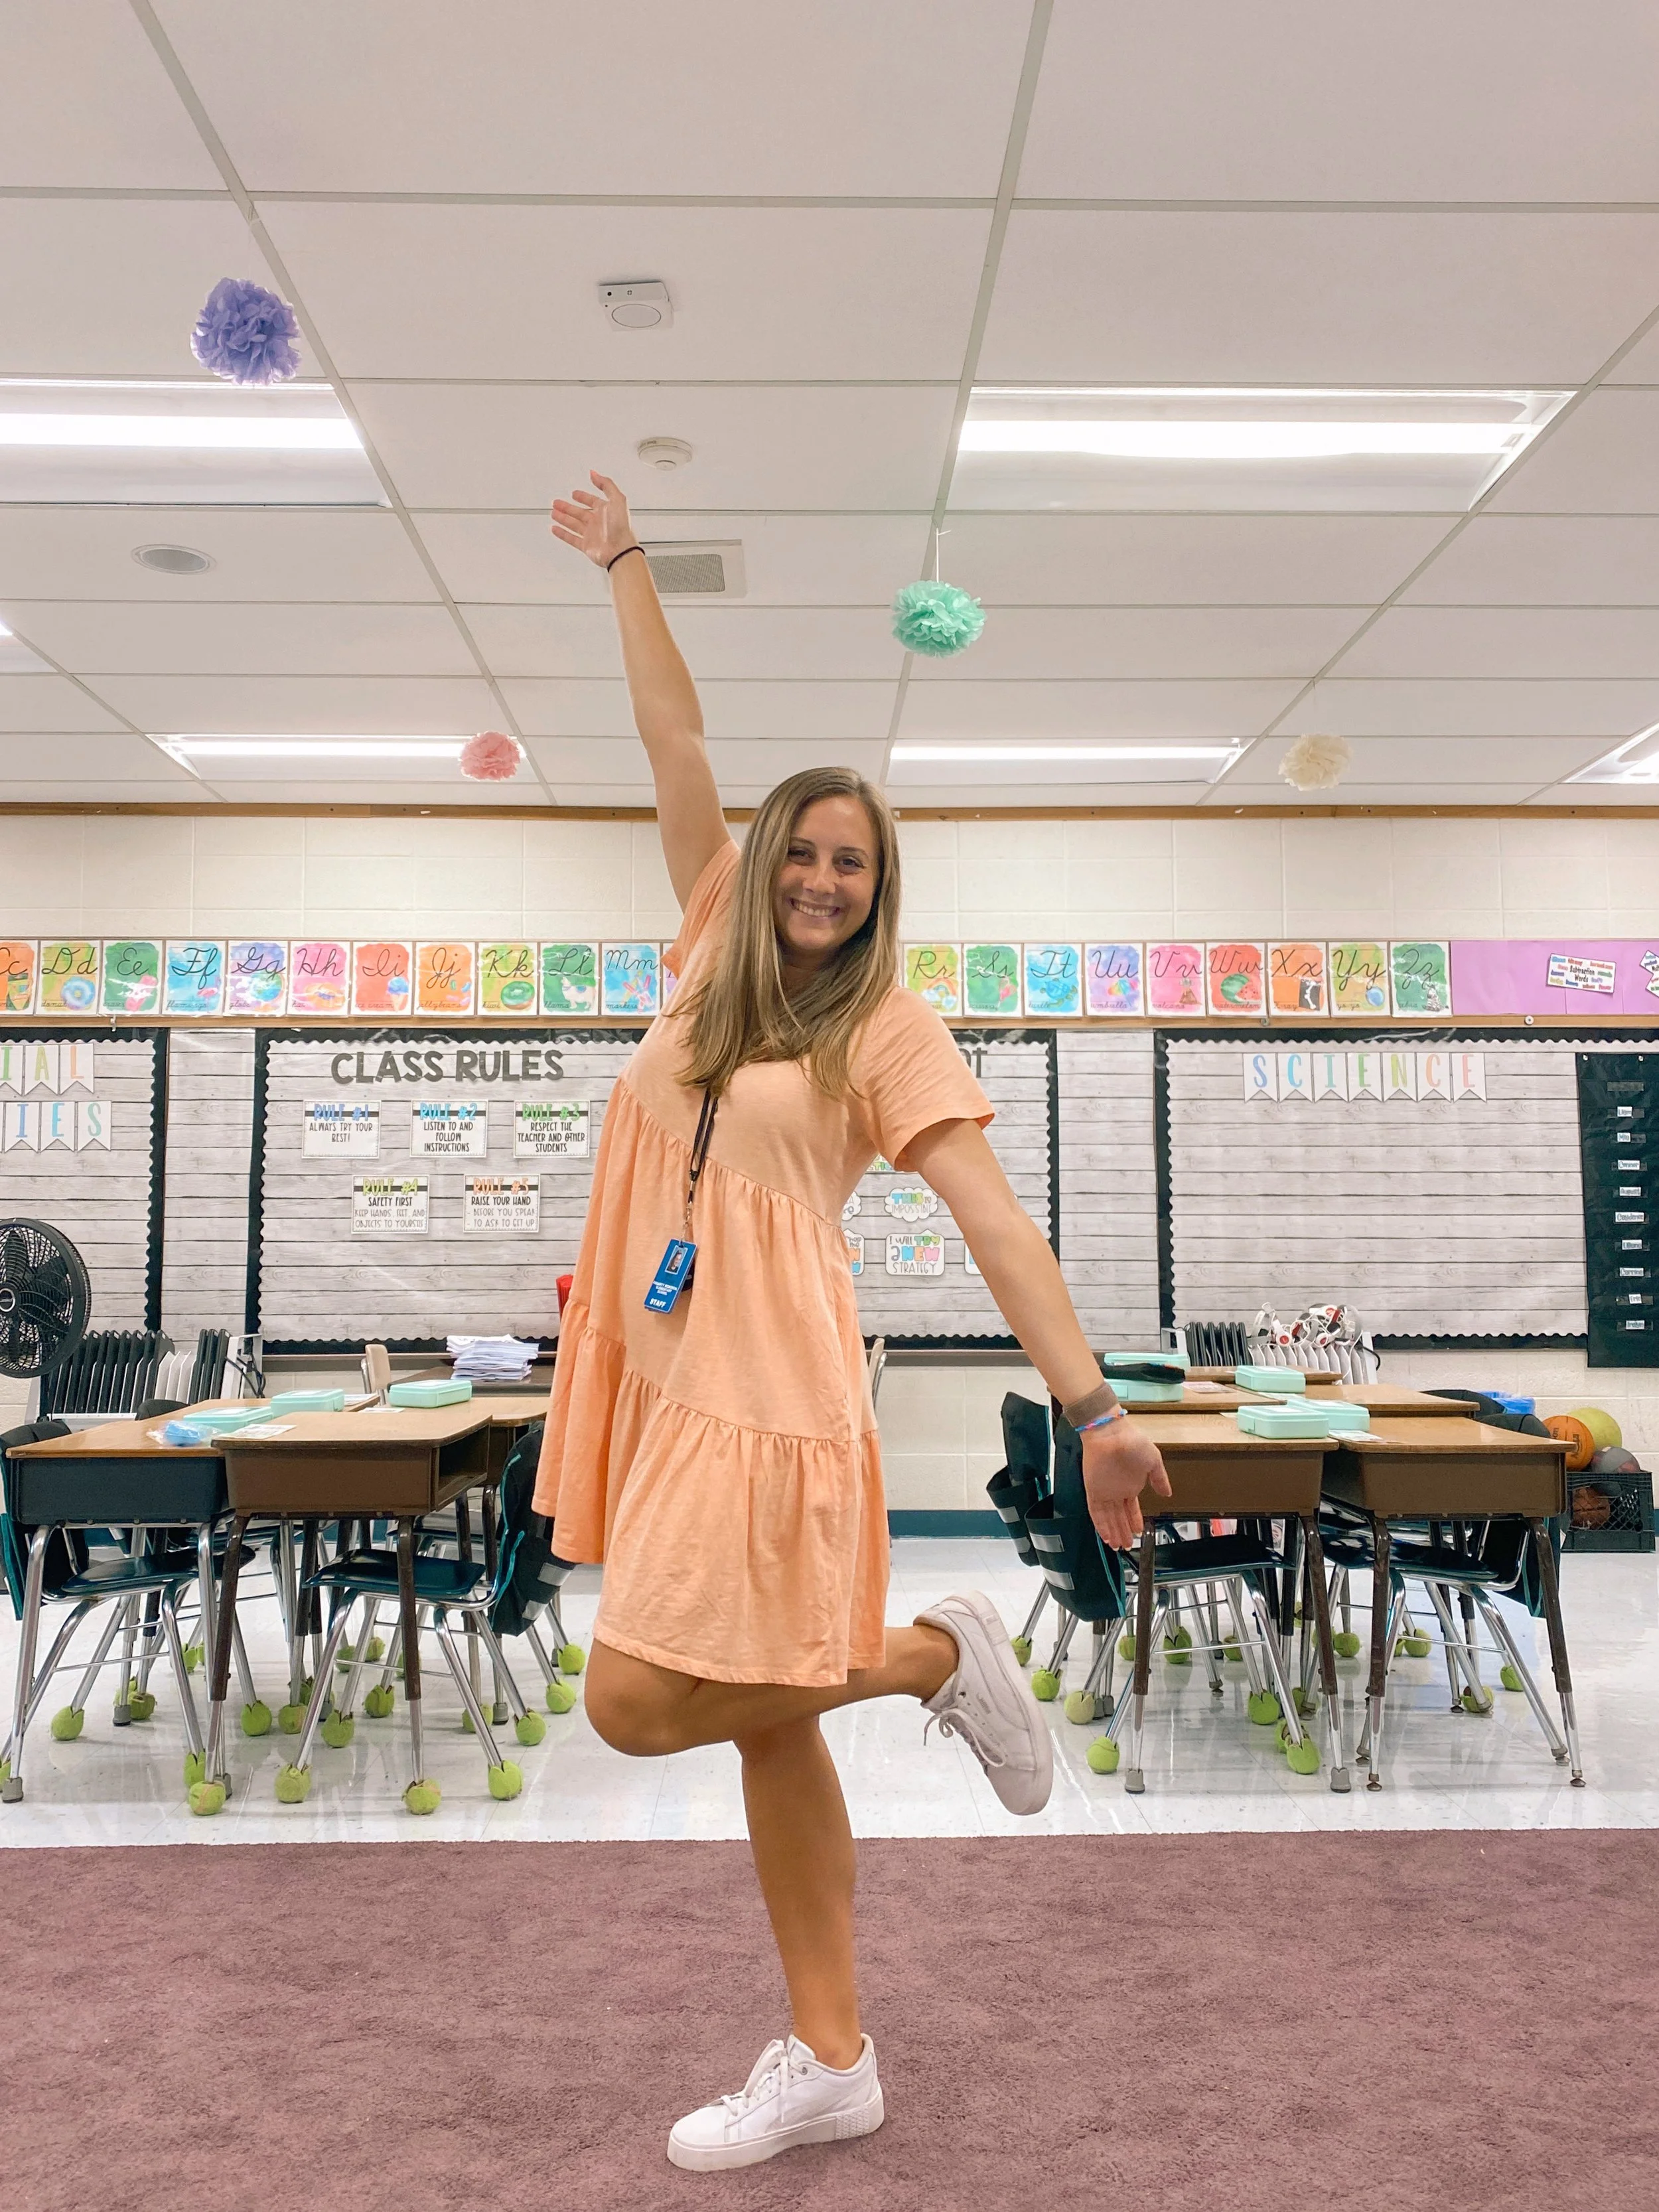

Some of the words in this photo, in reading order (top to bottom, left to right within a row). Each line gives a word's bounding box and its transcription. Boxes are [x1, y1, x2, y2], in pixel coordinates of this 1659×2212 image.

[42, 947, 98, 974] Dd
[117, 948, 149, 976] Ee
[171, 947, 218, 990] Ff
[231, 947, 286, 981] Gg
[297, 948, 344, 976] Hh
[362, 947, 405, 976] Ii
[426, 947, 461, 989] Jj
[486, 949, 534, 978] Kk
[549, 948, 593, 976] Ll
[606, 950, 659, 971] Mm
[912, 951, 955, 979] Rr
[972, 950, 1015, 979] Ss
[1031, 950, 1076, 979] Tt
[1092, 950, 1139, 978] Uu
[1150, 950, 1202, 978] Vv
[1209, 950, 1263, 974] Ww
[1272, 950, 1323, 978] Xx
[1333, 950, 1386, 991] Yy
[1395, 950, 1439, 990] Zz
[1574, 974, 1589, 983] Words
[331, 1051, 444, 1084] CLASS
[455, 1050, 564, 1082] RULES
[1254, 1053, 1475, 1088] SCIENCE
[313, 1103, 345, 1122] RULE
[352, 1104, 369, 1122] #1
[419, 1102, 451, 1122] RULE
[458, 1102, 478, 1122] #2
[522, 1102, 553, 1122] RULE
[559, 1102, 581, 1122] #3
[309, 1122, 336, 1132] ALWAYS
[340, 1122, 352, 1131] TRY
[356, 1122, 373, 1132] YOUR
[423, 1122, 445, 1131] LISTEN
[449, 1122, 457, 1131] TO
[459, 1122, 473, 1131] AND
[530, 1122, 557, 1132] RESPECT
[561, 1122, 572, 1131] THE
[331, 1133, 350, 1143] BEST!
[435, 1132, 461, 1142] FOLLOW
[518, 1132, 546, 1142] TEACHER
[549, 1133, 562, 1142] AND
[565, 1133, 585, 1142] OTHER
[424, 1143, 470, 1152] INSTRUCTIONS
[536, 1143, 567, 1153] STUDENTS
[363, 1178, 394, 1196] RULE
[401, 1178, 418, 1196] #4
[473, 1178, 504, 1196] RULE
[511, 1178, 529, 1195] #5
[368, 1197, 393, 1207] SAFETY
[396, 1197, 413, 1207] FIRST
[471, 1196, 490, 1206] RAISE
[493, 1196, 510, 1206] YOUR
[513, 1196, 531, 1206] HAND
[891, 1192, 924, 1205] THIS
[473, 1218, 482, 1227] TO
[485, 1218, 499, 1227] ASK
[502, 1218, 510, 1227] TO
[513, 1218, 524, 1227] GET
[526, 1218, 535, 1227] UP
[516, 1208, 535, 1217] SPEAK
[355, 1219, 382, 1228] OBJECTS
[384, 1219, 393, 1228] TO
[914, 1235, 940, 1246] TRY
[901, 1246, 940, 1262] NEW
[893, 1262, 937, 1274] STRATEGY
[650, 1297, 666, 1307] STAFF
